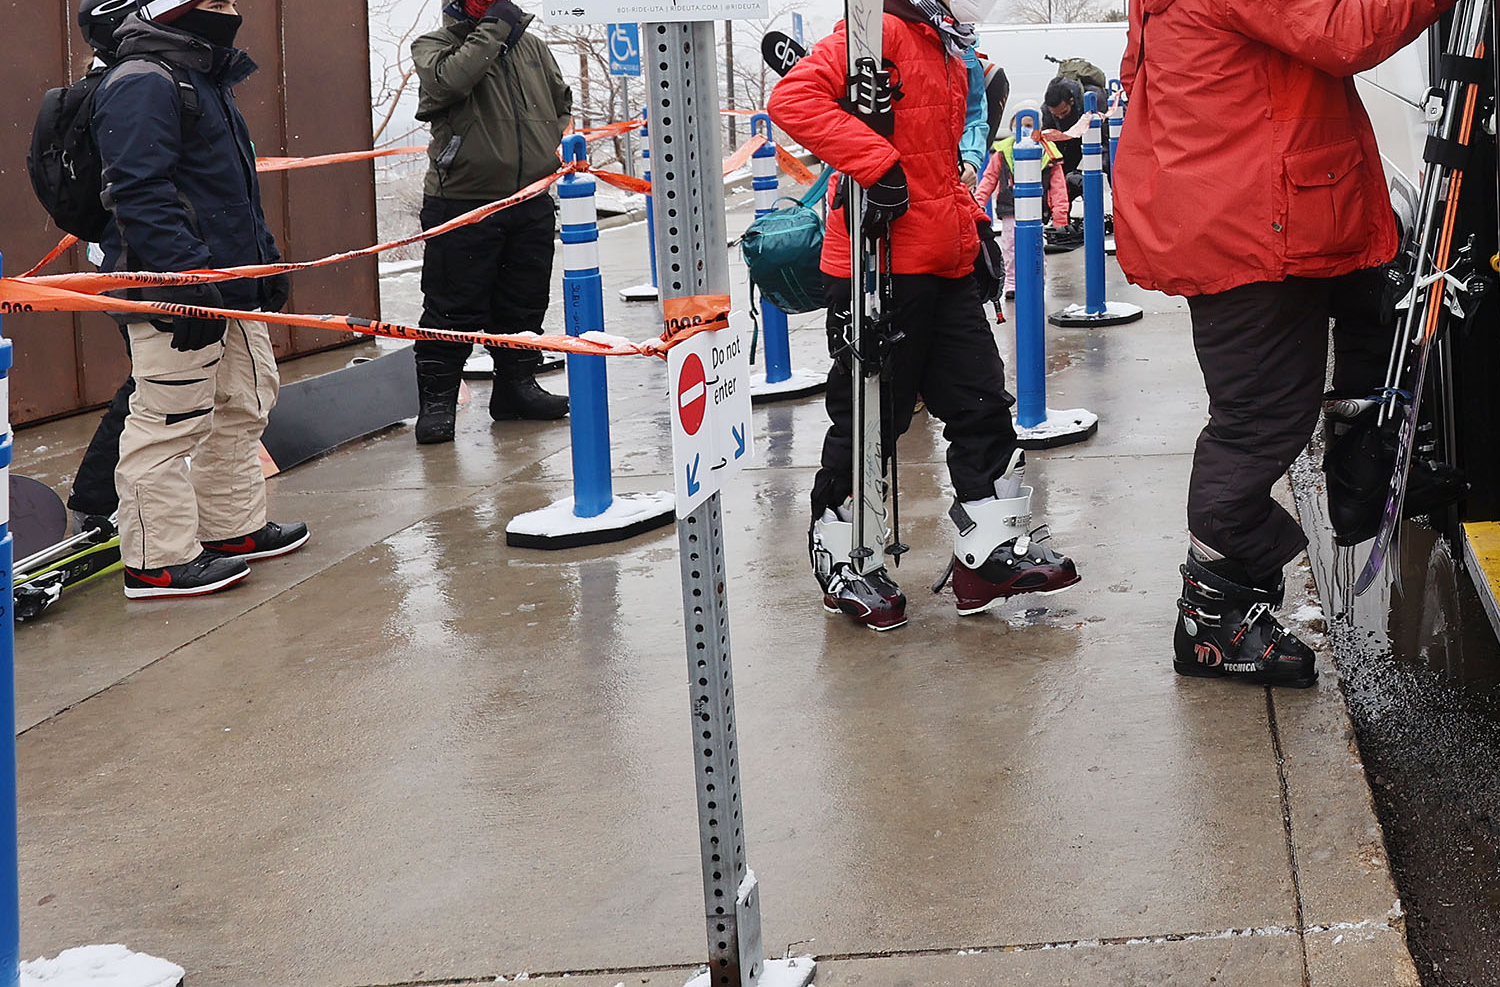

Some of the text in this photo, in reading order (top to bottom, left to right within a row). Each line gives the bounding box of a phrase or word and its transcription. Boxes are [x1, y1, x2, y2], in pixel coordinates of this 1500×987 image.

[617, 6, 664, 14] 801-RIDE-UTA
[670, 4, 718, 12] RIDEUTA.COM
[712, 335, 741, 370] Do not
[714, 376, 737, 406] enter
[1223, 662, 1257, 673] TECNICA
